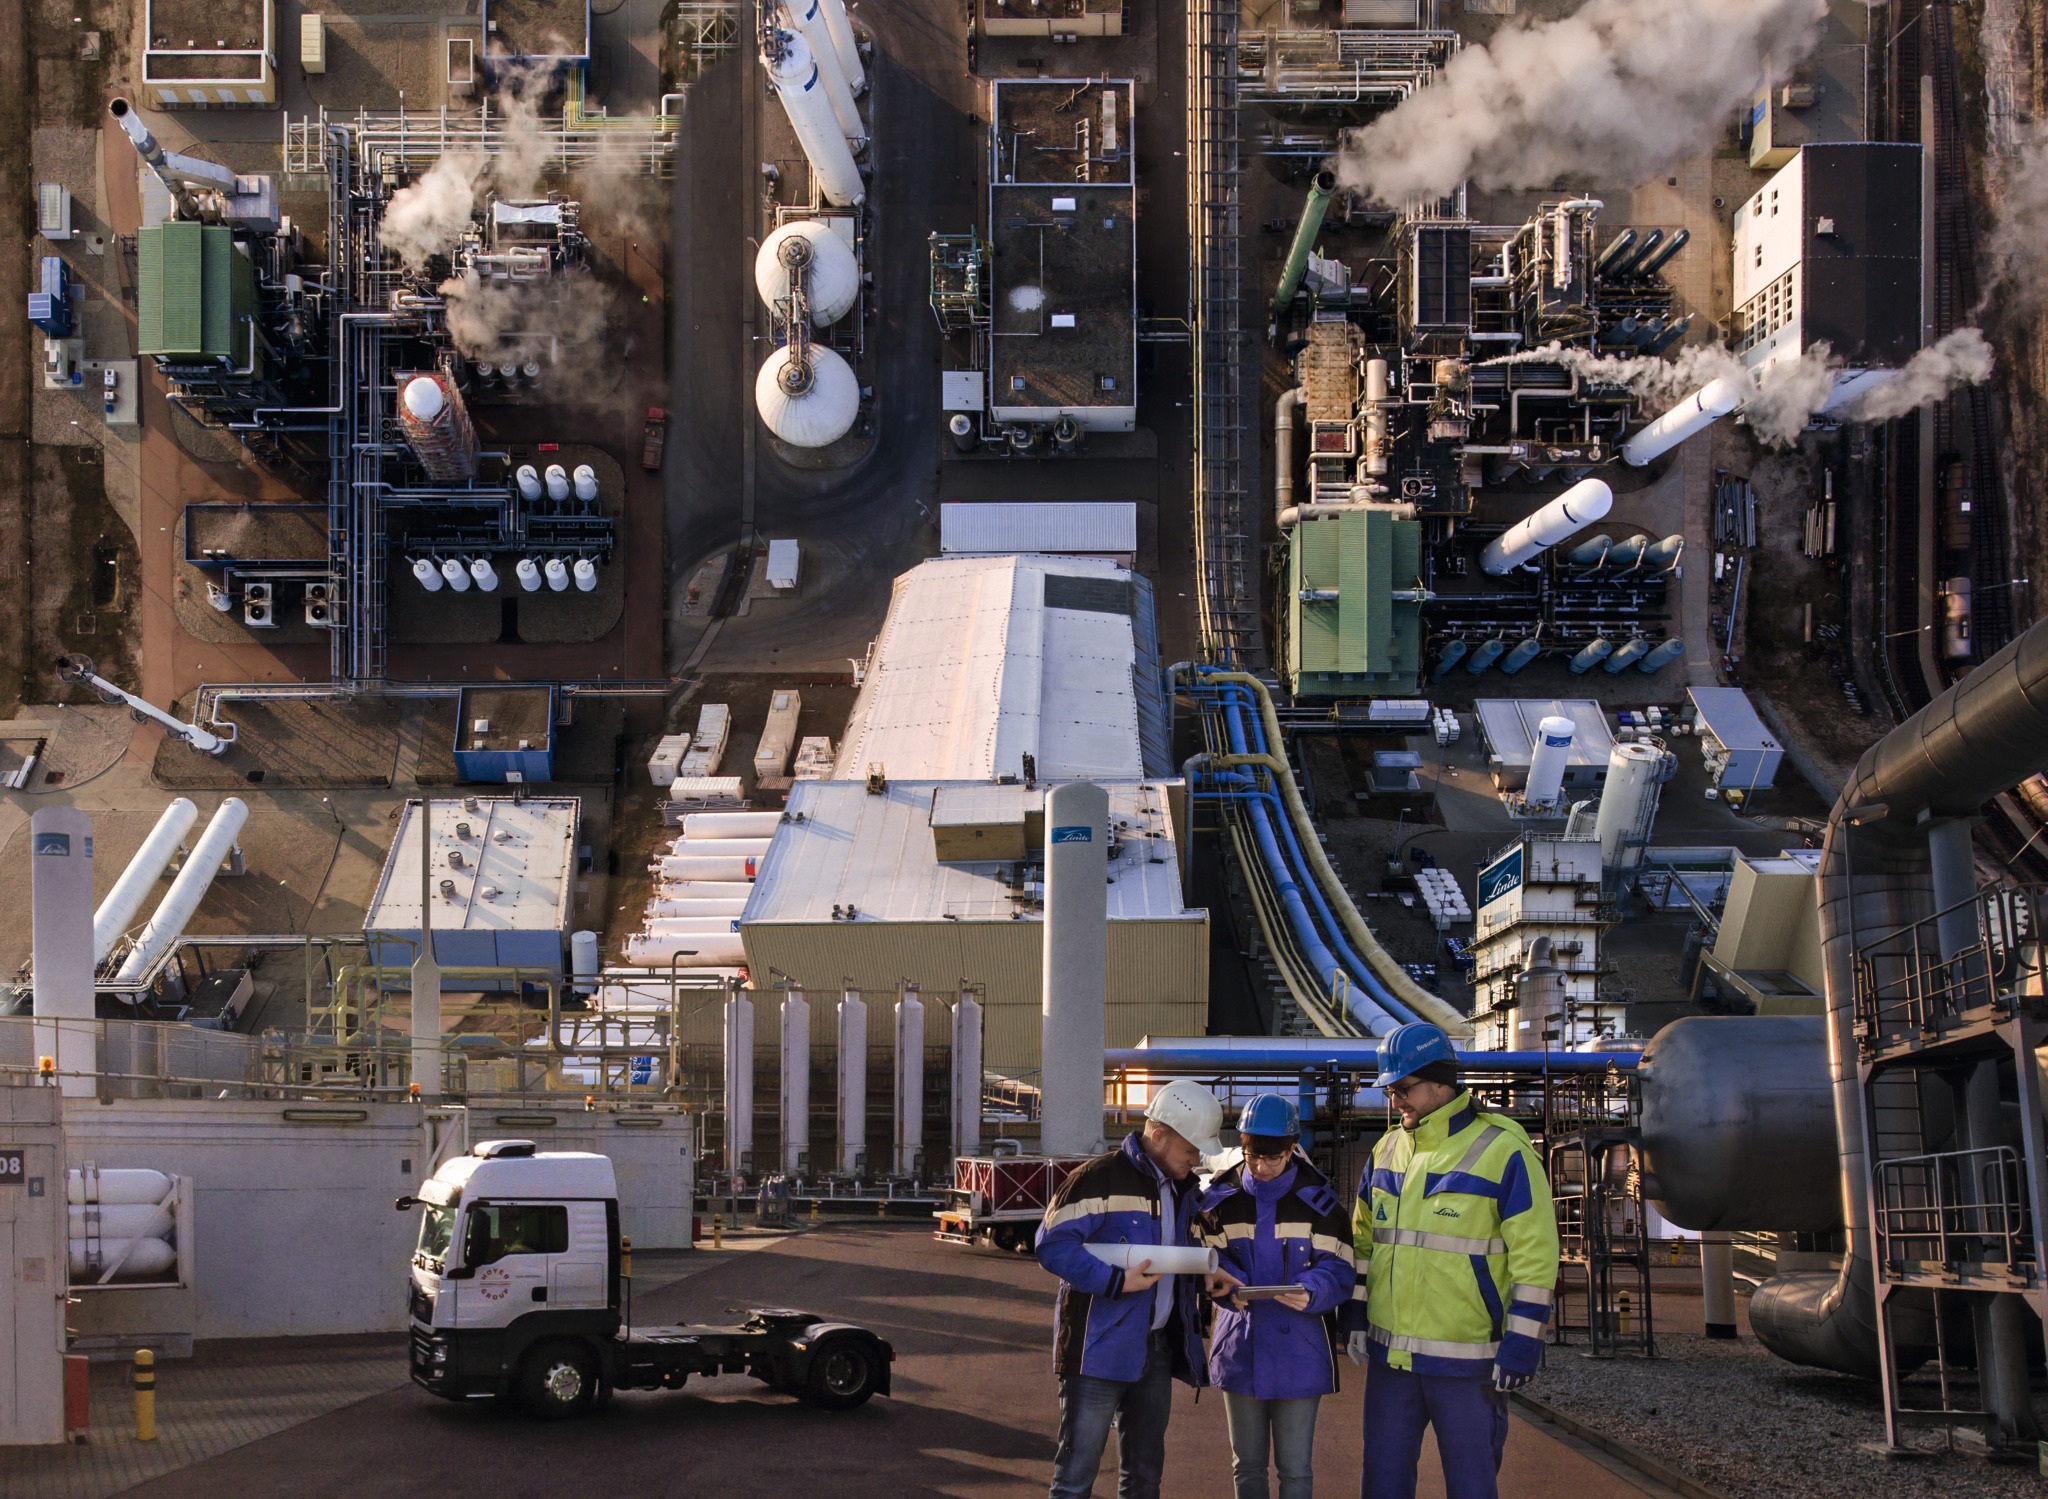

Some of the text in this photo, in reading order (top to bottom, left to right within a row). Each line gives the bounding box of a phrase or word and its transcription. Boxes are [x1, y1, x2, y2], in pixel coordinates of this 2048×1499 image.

[1058, 832, 1090, 842] Linde
[1485, 873, 1520, 902] Linde
[1433, 1207, 1460, 1219] Linde
[481, 1268, 510, 1280] HOYER
[481, 1288, 509, 1300] GROUP
